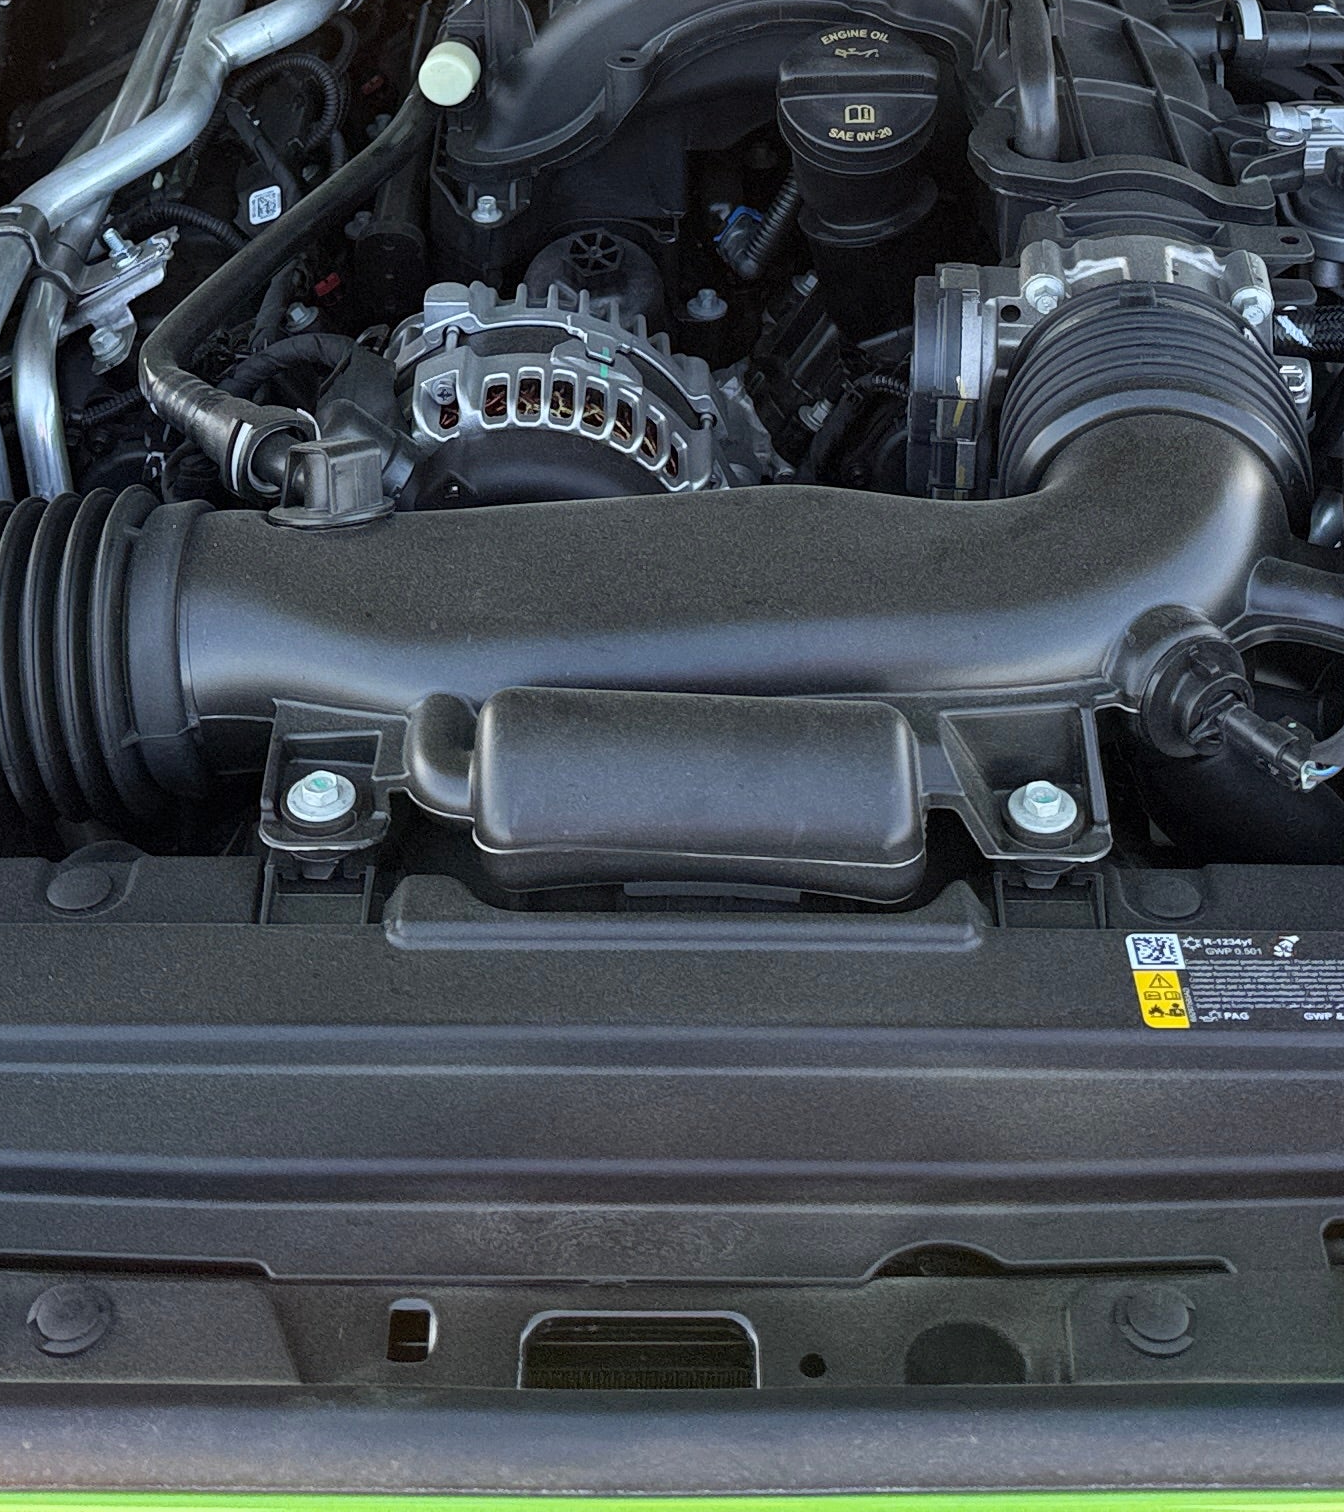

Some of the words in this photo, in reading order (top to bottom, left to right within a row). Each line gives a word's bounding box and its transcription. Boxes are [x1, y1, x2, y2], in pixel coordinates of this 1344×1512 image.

[820, 29, 868, 46] ENGINE
[869, 30, 891, 44] OIL
[828, 127, 854, 142] SAE
[856, 126, 893, 142] 0W-20
[1203, 937, 1253, 947] R-1234yf
[1205, 947, 1231, 956] GWP
[1234, 947, 1263, 956] 0.501
[1223, 1012, 1250, 1021] PAG
[1303, 1011, 1333, 1021] GWP
[1336, 1011, 1344, 1021] &
